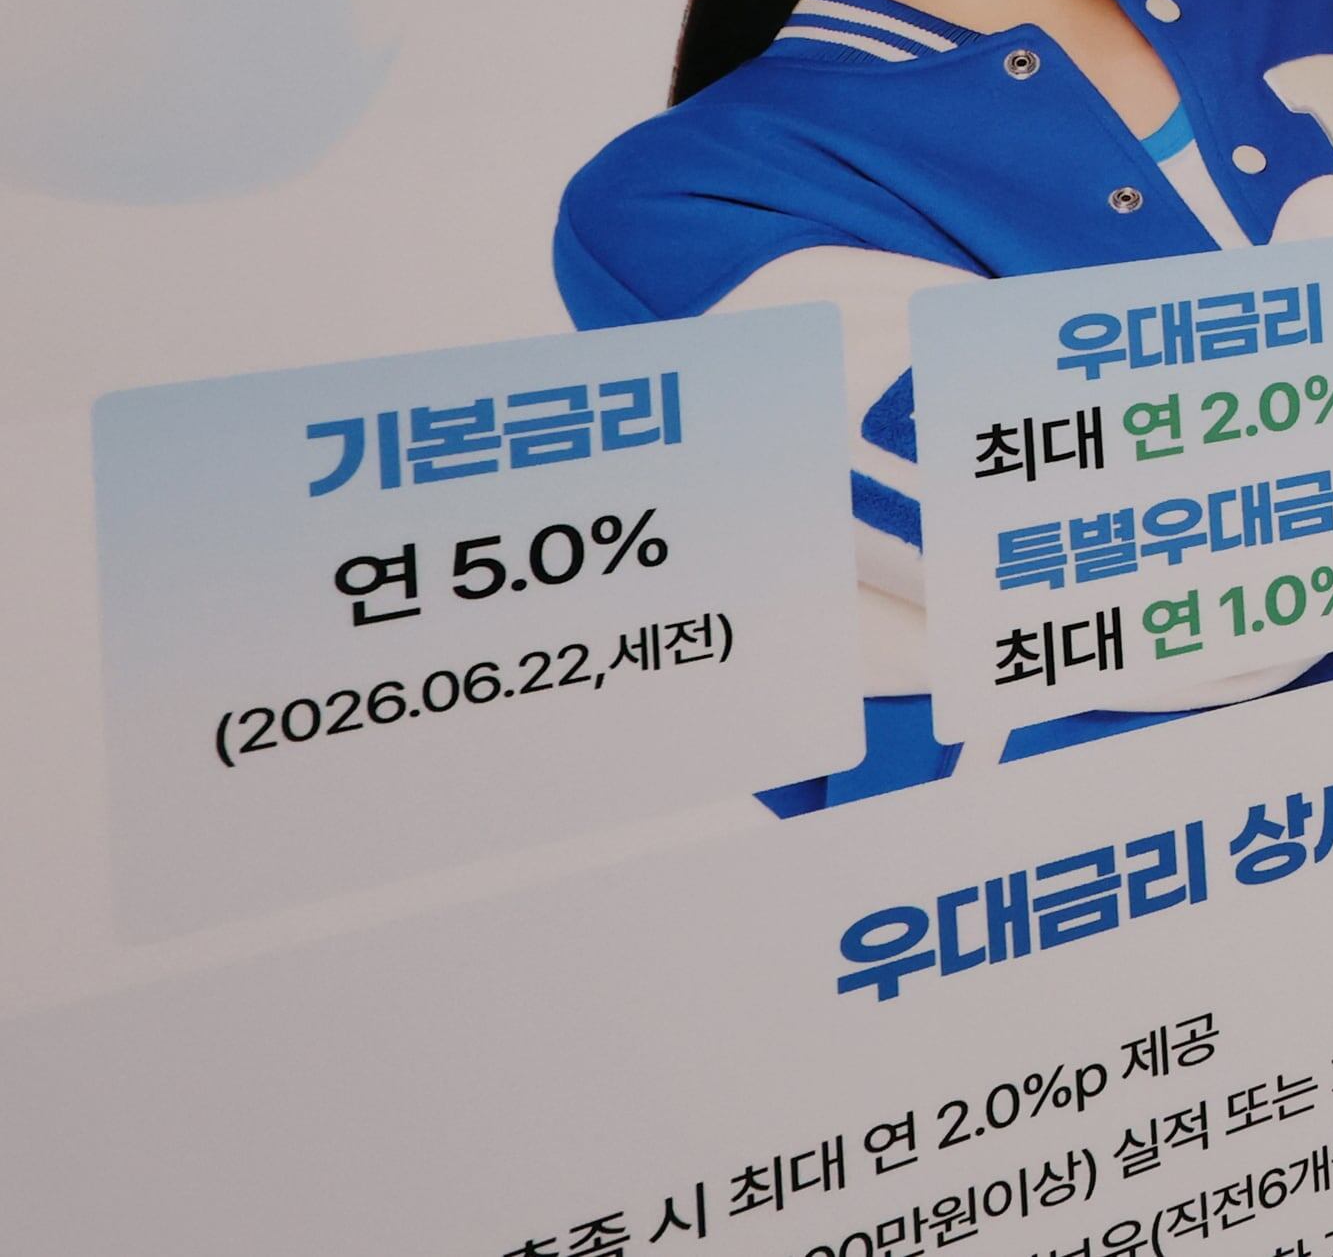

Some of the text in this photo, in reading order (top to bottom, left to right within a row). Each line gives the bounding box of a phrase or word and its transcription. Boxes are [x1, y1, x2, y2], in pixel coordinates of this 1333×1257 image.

[1057, 282, 1323, 381] 우대금리
[306, 371, 682, 498] 기본금리
[974, 406, 1104, 482] 최대
[1122, 393, 1184, 461] 연
[334, 508, 668, 627] 연 5.0%
[215, 613, 733, 768] (2026.06.22,세전)
[994, 606, 1124, 686] 최대
[1142, 589, 1203, 660] 연
[837, 820, 1208, 1002] 우대금리
[649, 1182, 706, 1244] 시
[729, 1134, 845, 1217] 최대
[864, 1110, 918, 1175] 연
[937, 1063, 1107, 1150] 2.0%p
[1120, 1012, 1220, 1079] 제공
[1113, 1100, 1209, 1179] 실적
[1225, 1074, 1318, 1136] 또는
